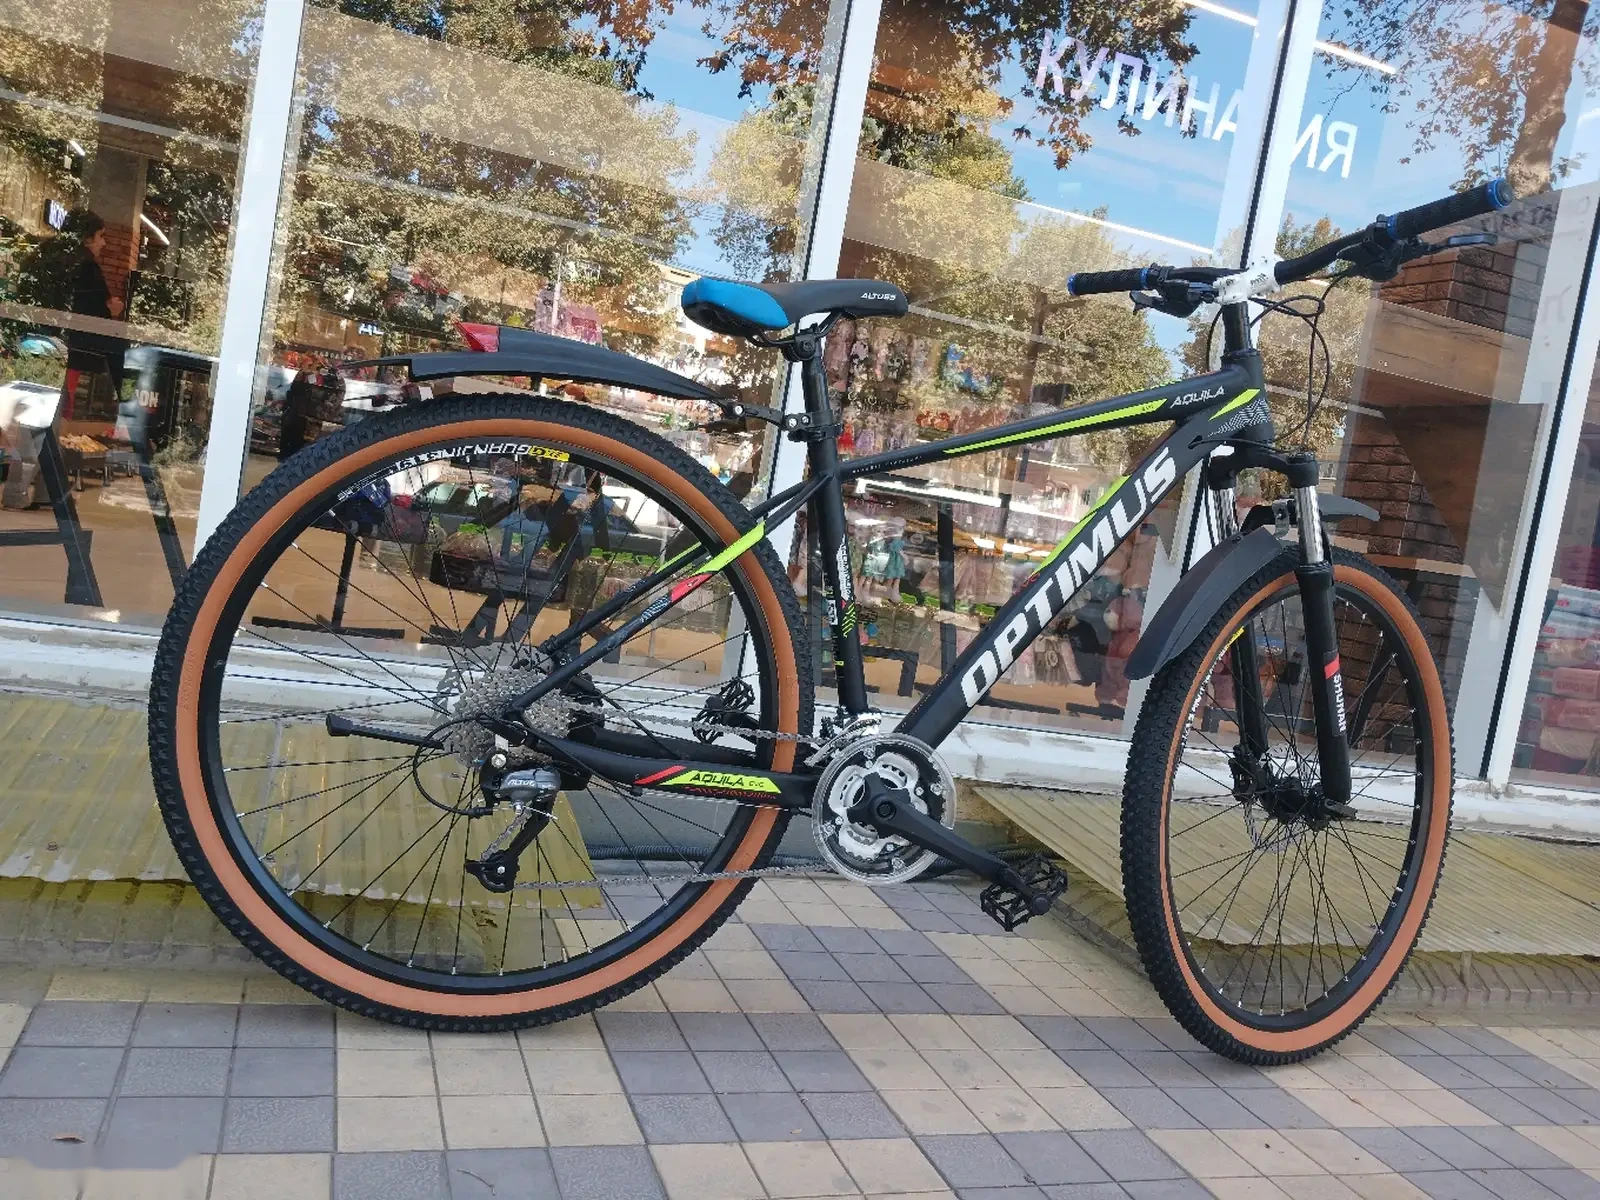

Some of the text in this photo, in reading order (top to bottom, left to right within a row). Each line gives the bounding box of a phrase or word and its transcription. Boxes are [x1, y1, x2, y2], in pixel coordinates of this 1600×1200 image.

[1169, 386, 1225, 409] AQUILA
[960, 446, 1177, 708] OPTIMUS
[689, 773, 745, 787] AQUILA
